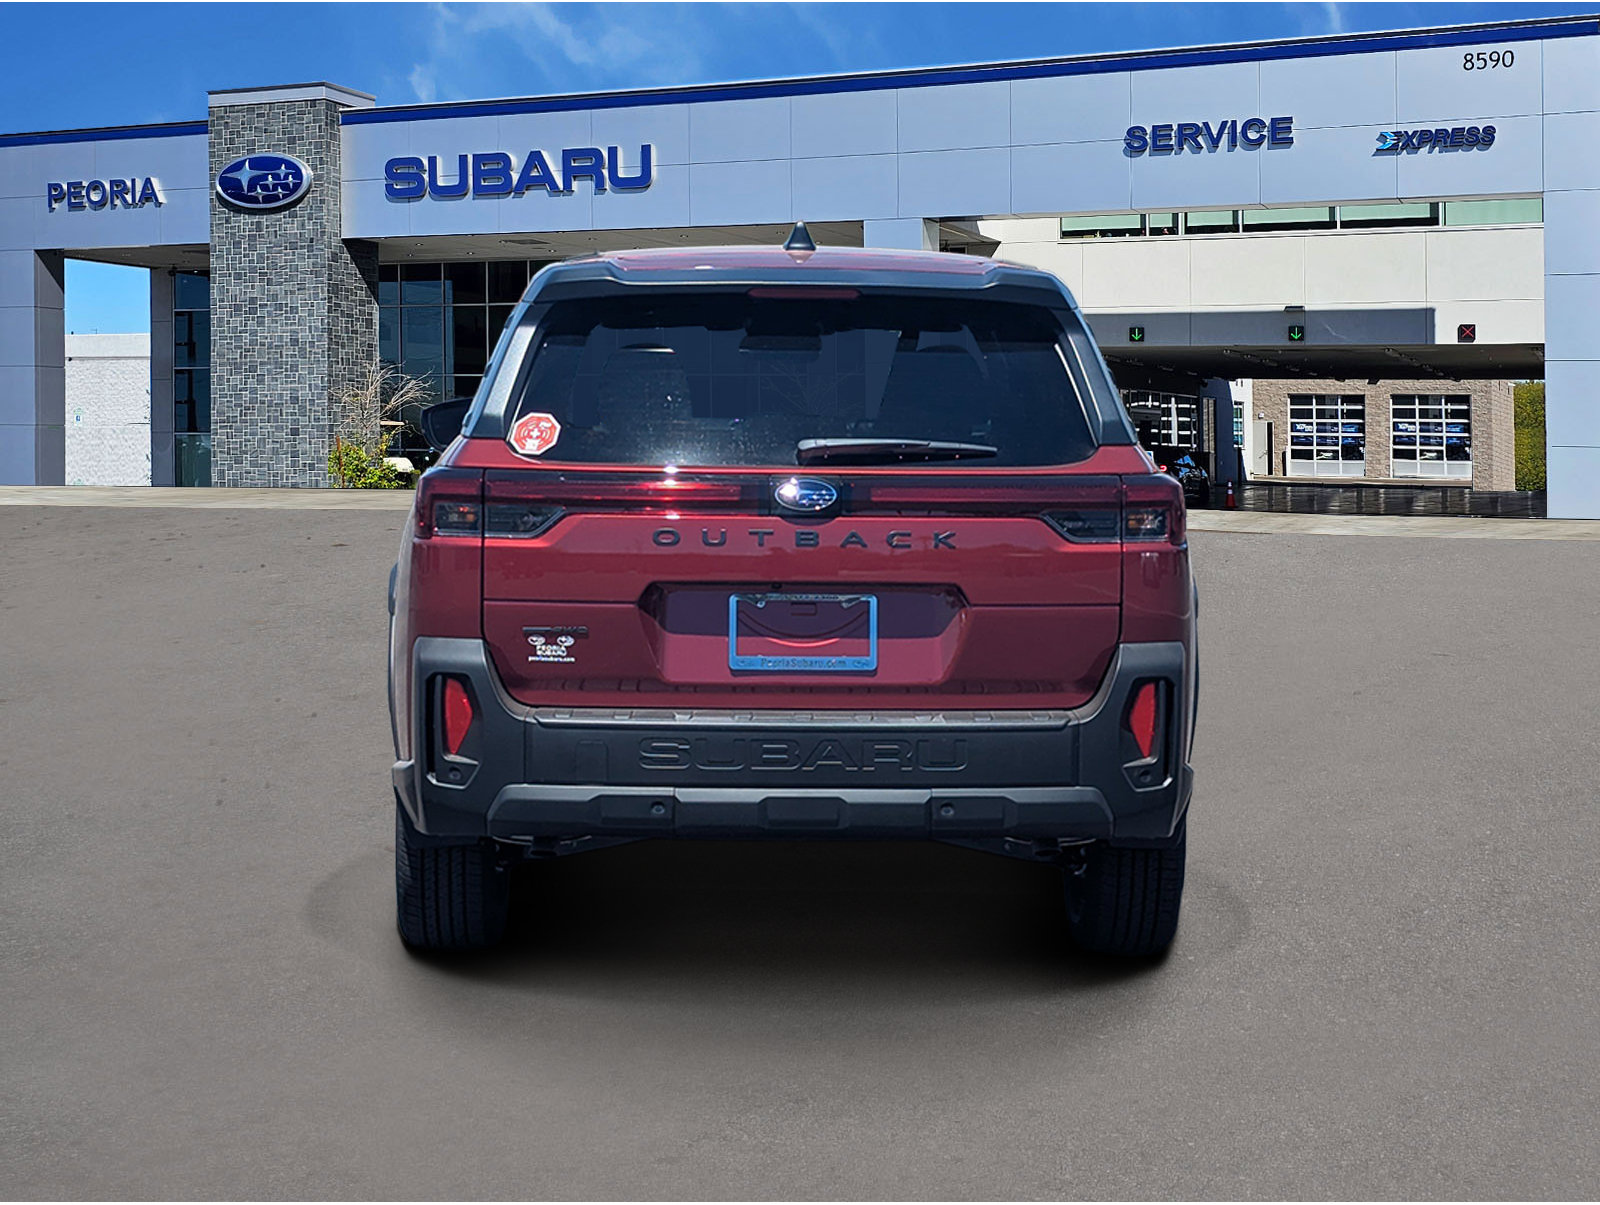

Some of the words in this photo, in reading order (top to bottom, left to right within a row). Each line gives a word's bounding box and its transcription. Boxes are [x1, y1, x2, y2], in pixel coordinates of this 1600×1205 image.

[1463, 50, 1514, 71] 8590
[1125, 116, 1294, 152] SERVICE
[1376, 125, 1496, 151] EXPRESS
[384, 143, 652, 199] SUBARU
[47, 177, 162, 210] PEORIA
[652, 528, 956, 549] OUTBACK
[761, 657, 847, 668] PeoriaSubaru.com
[638, 736, 969, 772] SUBARU
